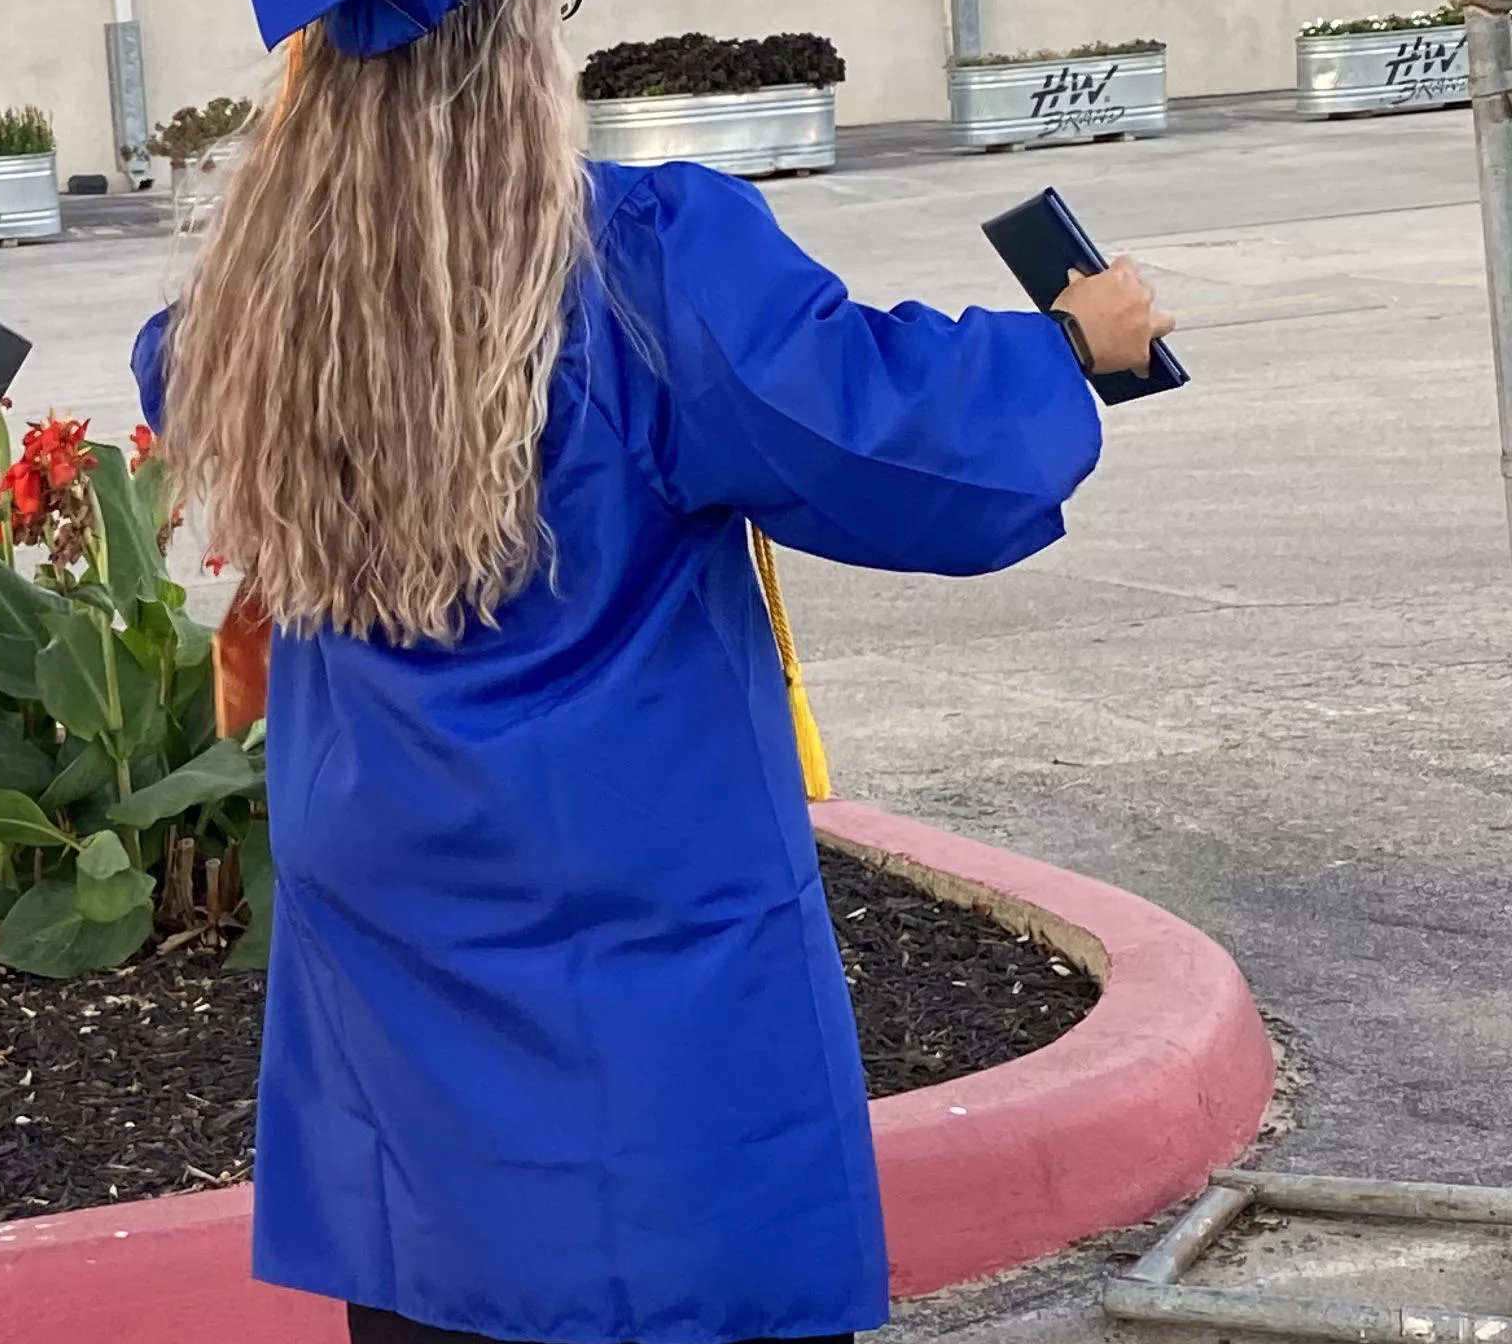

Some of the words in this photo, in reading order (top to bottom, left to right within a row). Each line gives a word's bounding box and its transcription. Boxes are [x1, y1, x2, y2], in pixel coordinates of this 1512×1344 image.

[1385, 36, 1467, 85] HW
[1030, 64, 1119, 118] HW
[1038, 106, 1125, 138] BRAND
